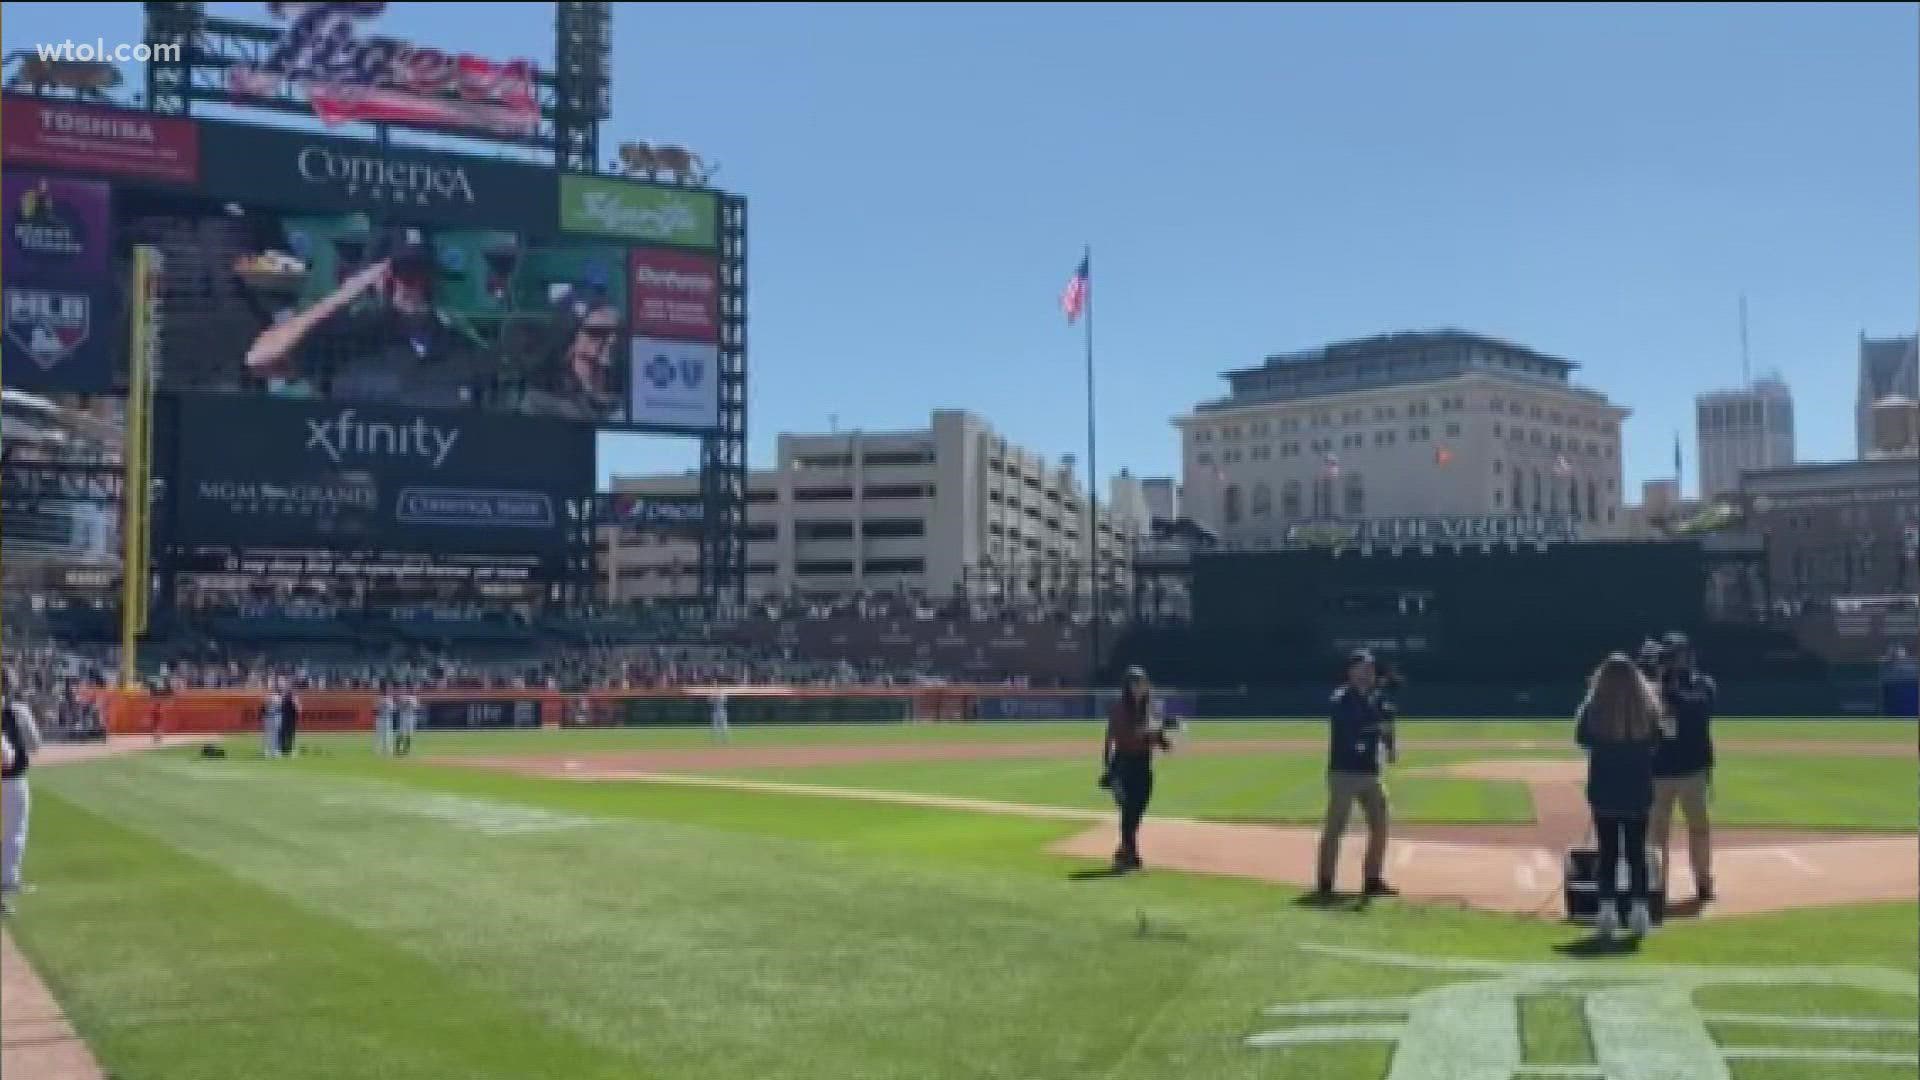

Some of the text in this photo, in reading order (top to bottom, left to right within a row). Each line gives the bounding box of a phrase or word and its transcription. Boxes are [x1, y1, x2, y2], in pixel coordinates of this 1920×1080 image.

[40, 110, 155, 143] TOSHIBA
[304, 408, 460, 468] xfinity
[199, 480, 257, 499] MGM
